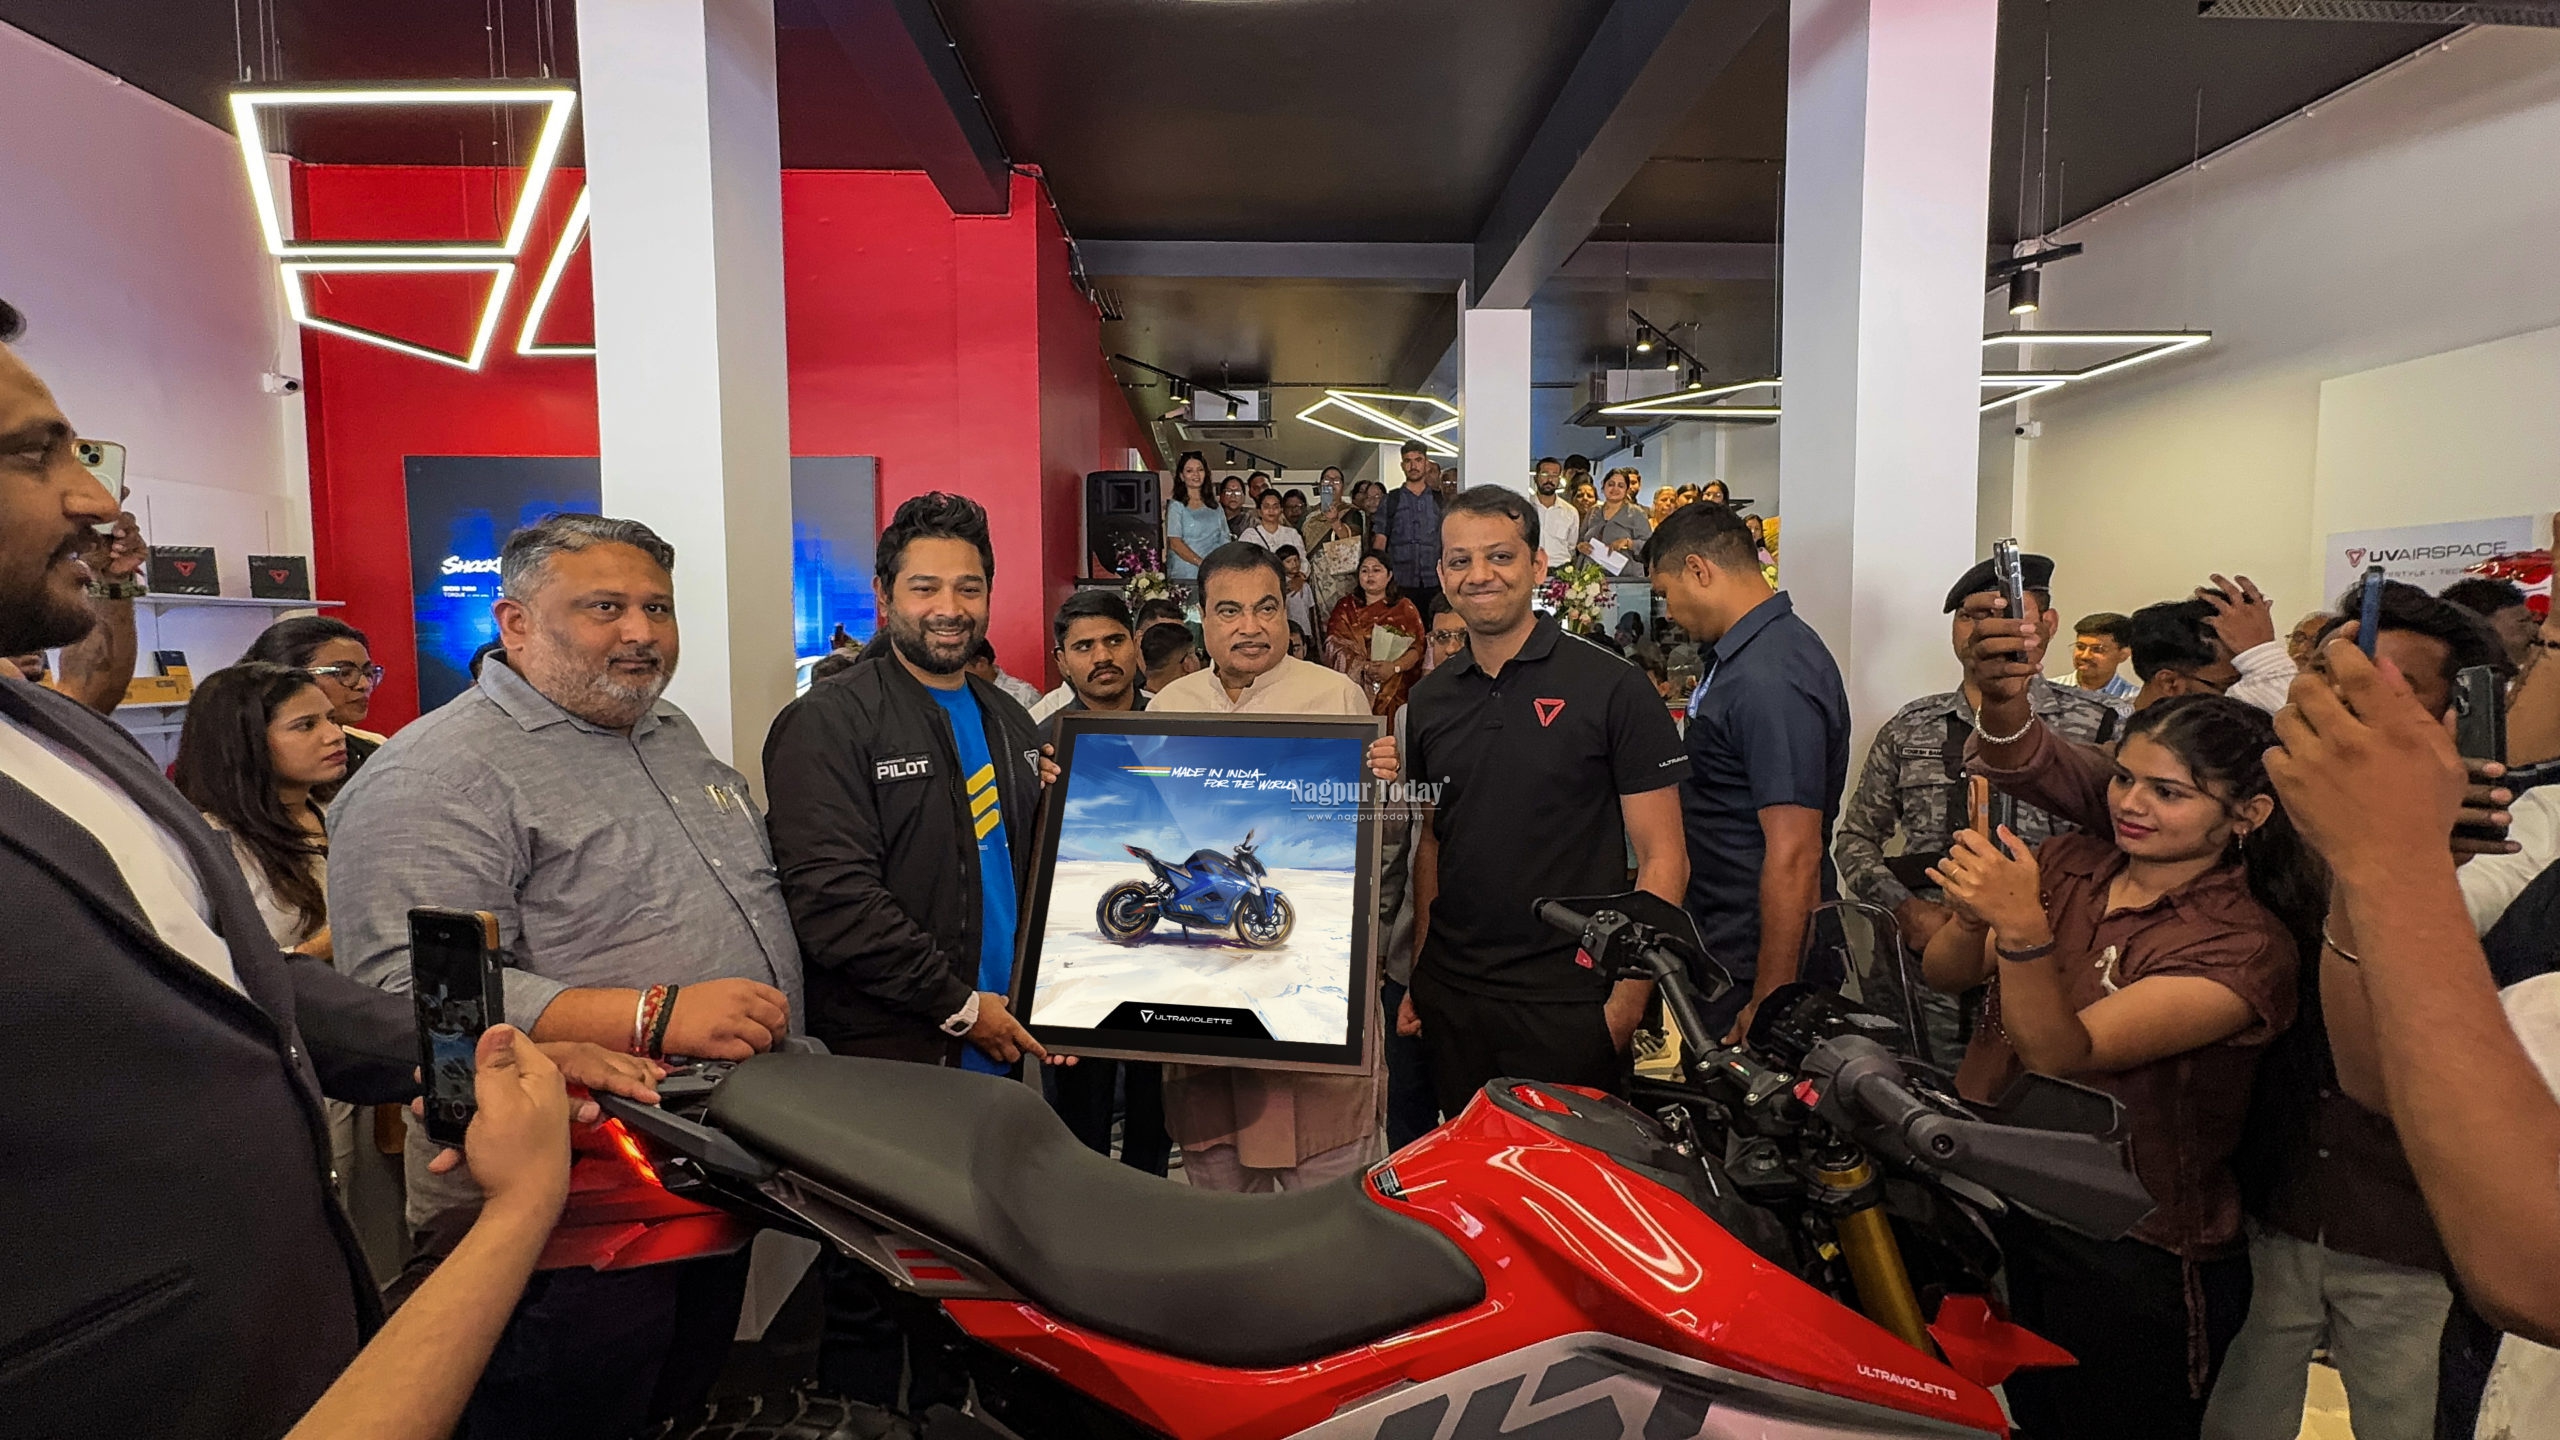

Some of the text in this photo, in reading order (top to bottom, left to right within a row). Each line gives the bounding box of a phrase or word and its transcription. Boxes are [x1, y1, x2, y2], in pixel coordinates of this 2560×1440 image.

[2369, 541, 2507, 563] UVAIRSPACE
[441, 555, 503, 575] SHOCK
[876, 760, 928, 779] PILOT
[1171, 766, 1267, 782] MADE IN INDIA
[1203, 779, 1297, 791] FOR THE WORLD
[1154, 1014, 1233, 1025] ULTRAVIOLETTE
[1856, 1363, 1957, 1400] ULTRAVIOLETTE
